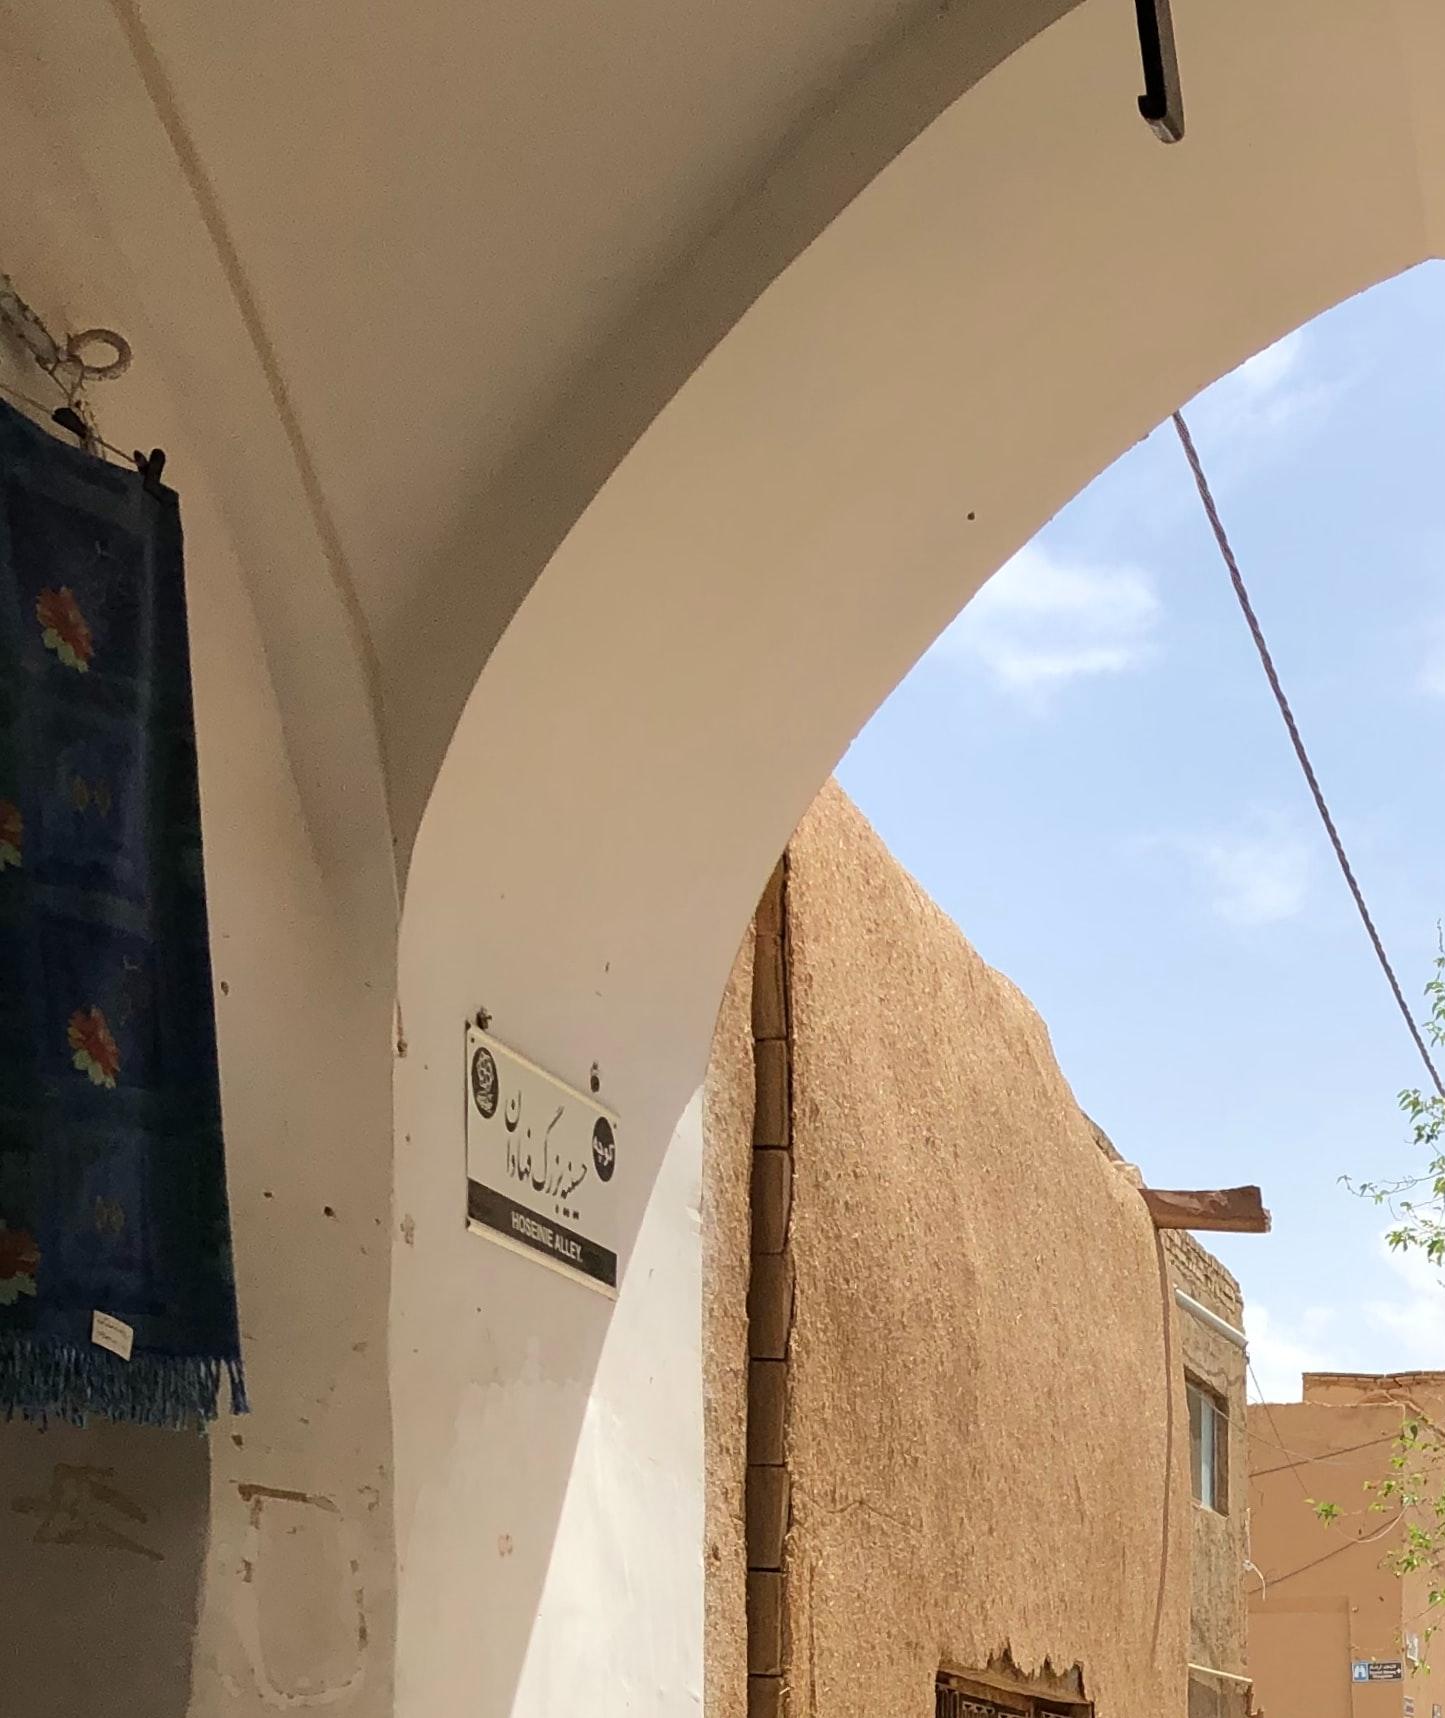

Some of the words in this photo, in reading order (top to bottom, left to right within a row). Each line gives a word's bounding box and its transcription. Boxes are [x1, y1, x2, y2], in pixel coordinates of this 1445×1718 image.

[532, 1106, 563, 1213] بزرگ
[592, 1135, 615, 1167] کوچه
[511, 1210, 554, 1248] HOSEINIE
